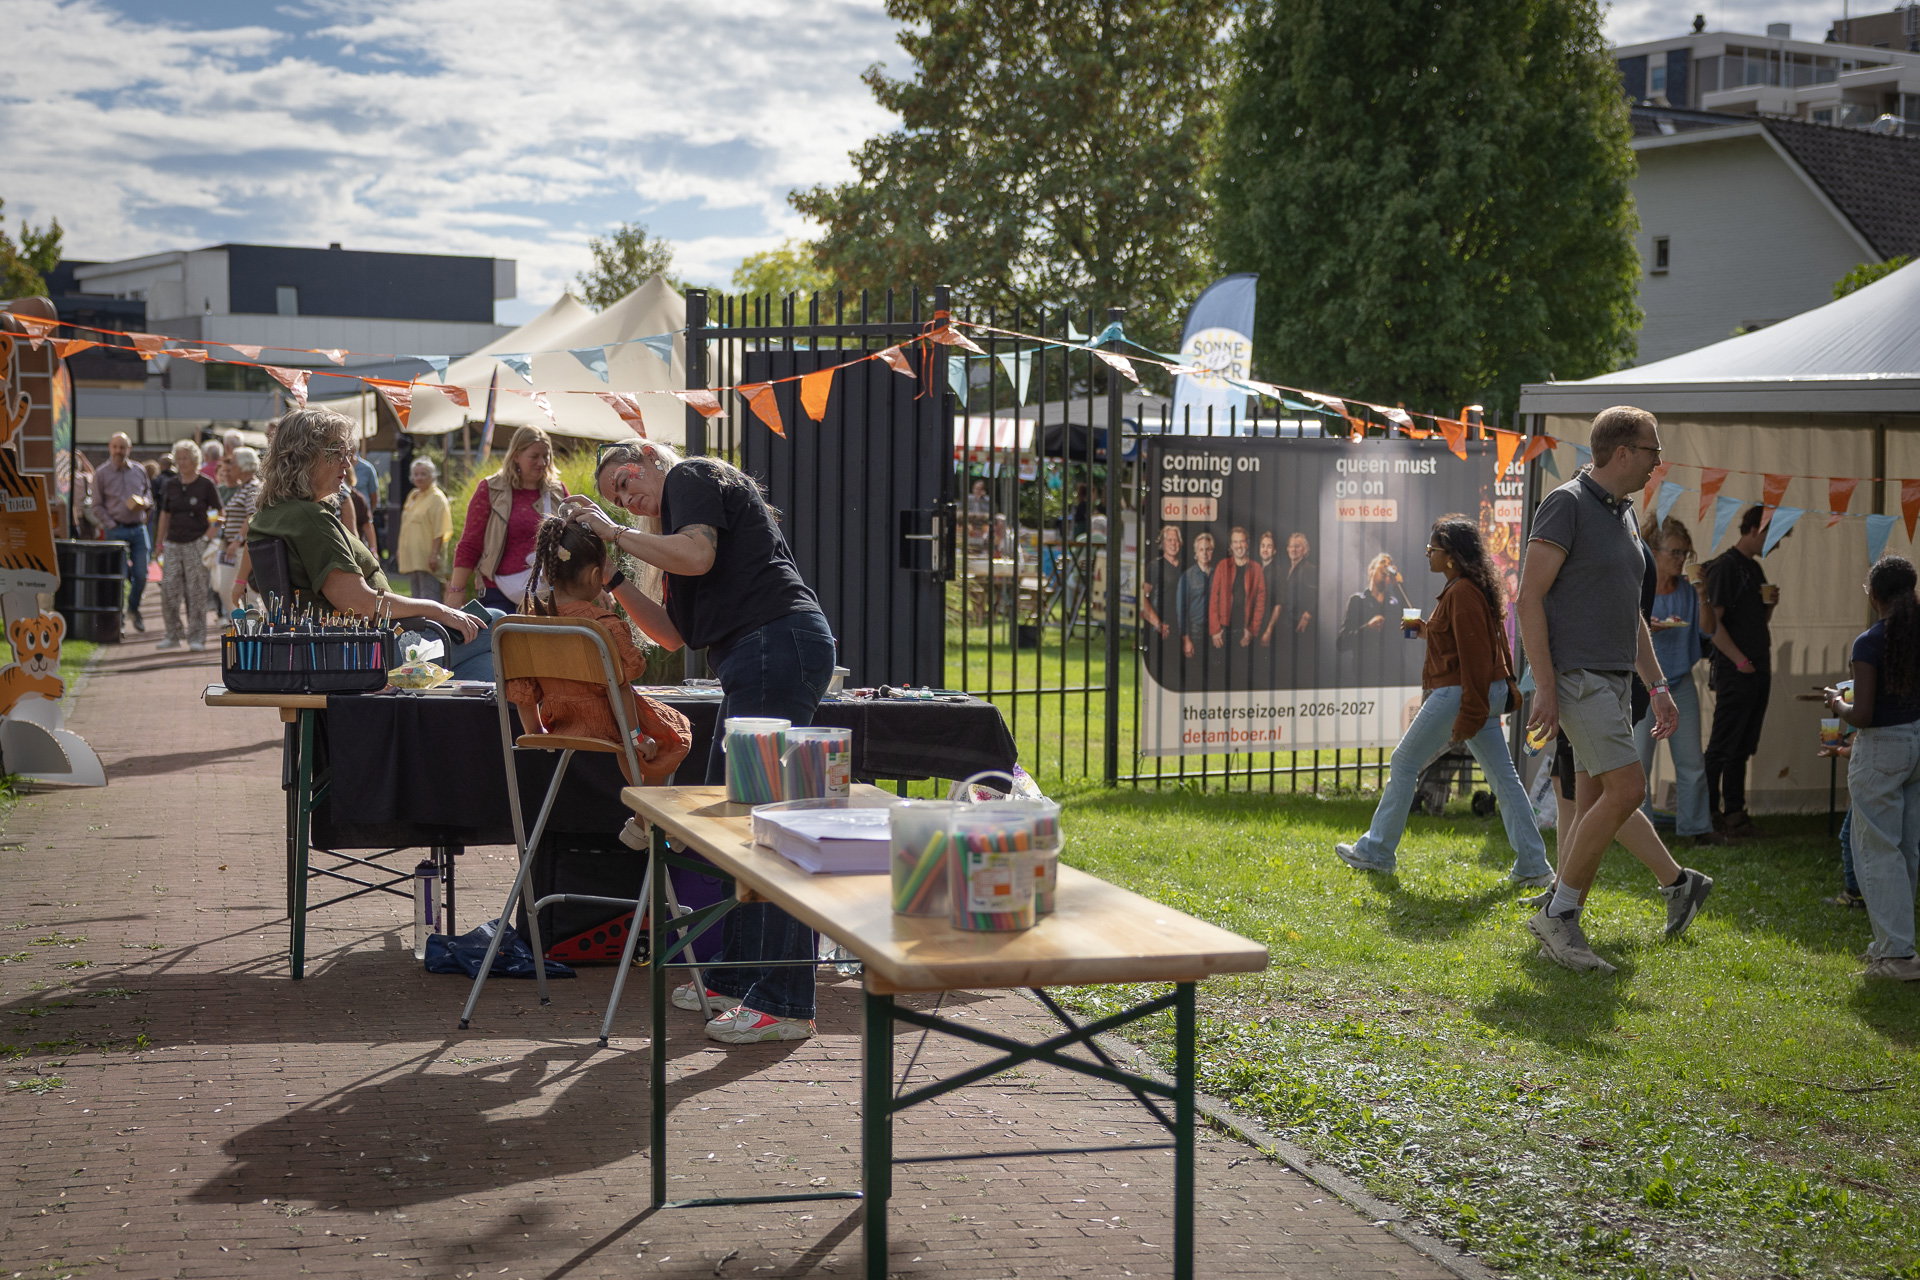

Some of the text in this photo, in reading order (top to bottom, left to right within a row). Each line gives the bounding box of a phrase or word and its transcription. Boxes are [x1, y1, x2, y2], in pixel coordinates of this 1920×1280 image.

[1193, 340, 1245, 359] SONNE
[1162, 451, 1260, 476] coming on
[1336, 456, 1437, 477] queen must
[1161, 474, 1224, 498] strong
[1335, 480, 1384, 498] go on
[1164, 504, 1211, 516] do 1 okt
[1338, 505, 1393, 517] wo 16 dec
[1497, 506, 1511, 517] do
[1183, 701, 1375, 720] theaterseizoen 2026-2027
[1182, 726, 1283, 744] detamboer.nl
